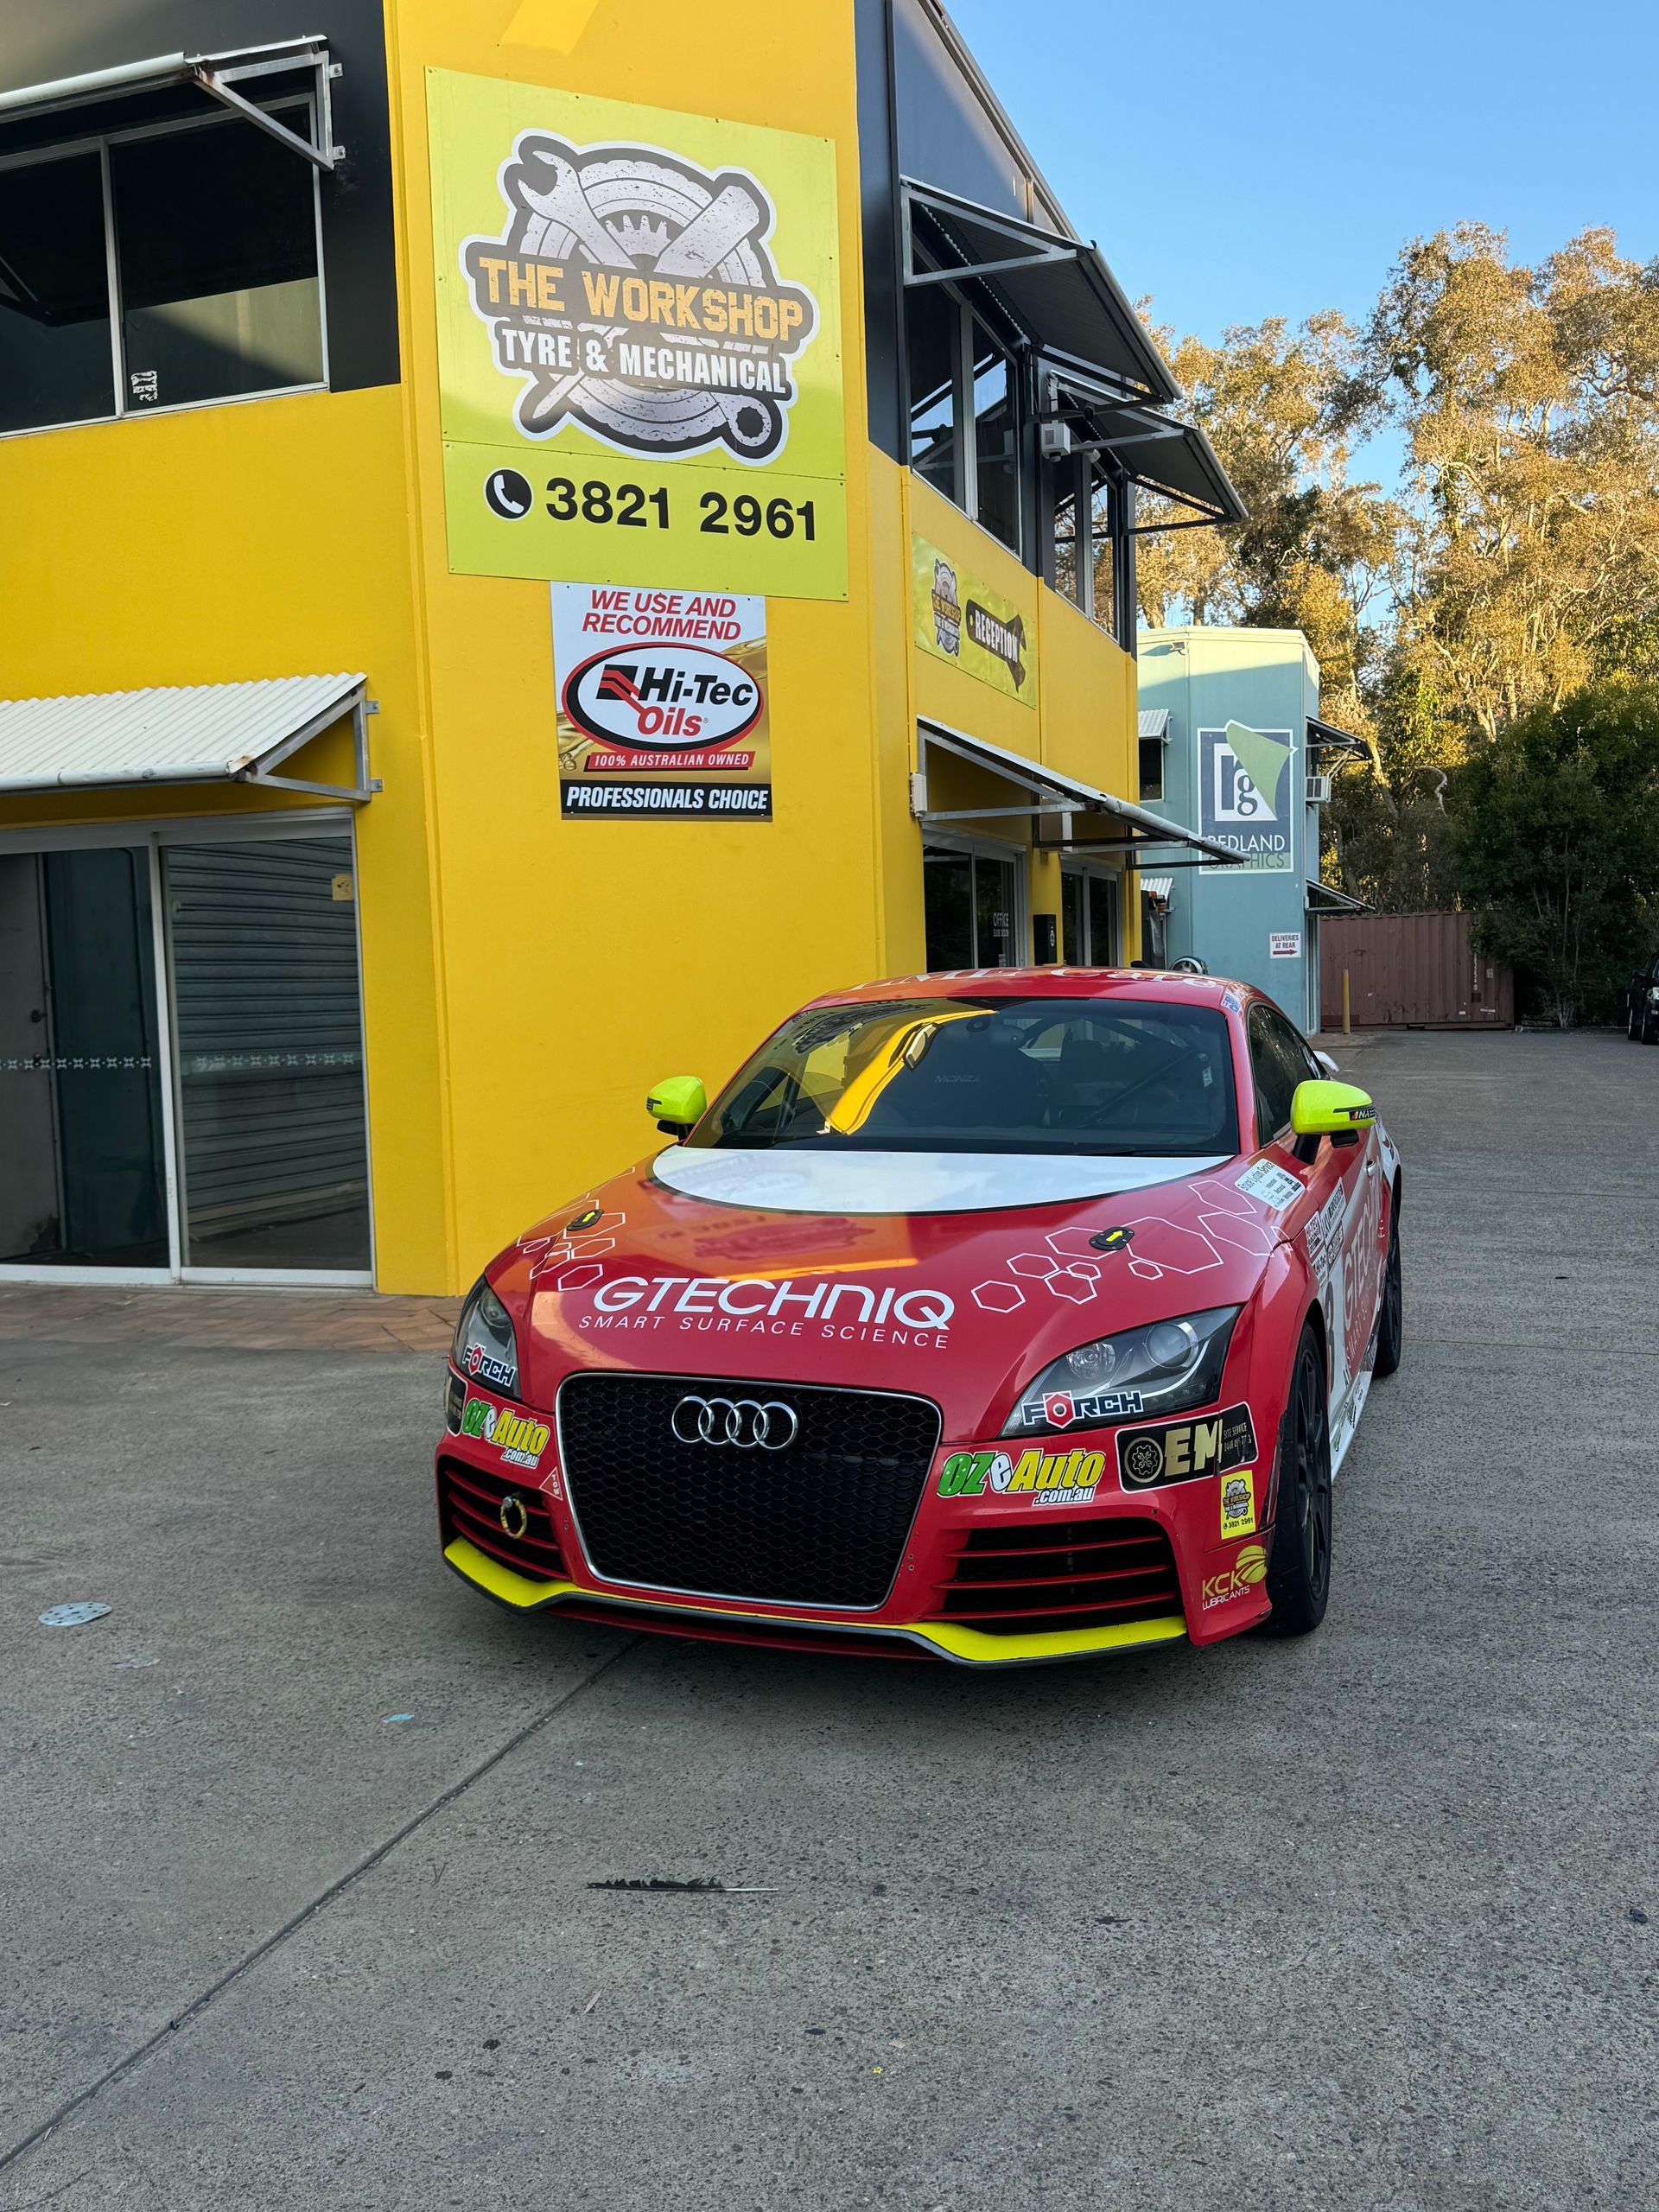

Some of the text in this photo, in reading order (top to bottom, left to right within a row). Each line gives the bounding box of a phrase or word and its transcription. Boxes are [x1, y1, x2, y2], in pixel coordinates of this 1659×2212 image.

[479, 257, 803, 341] THE WORKSHOP
[502, 327, 786, 395] TYRE & MECHANICAL
[545, 477, 816, 542] 3821 2961
[591, 589, 736, 618] WE USE AND
[582, 613, 741, 640] RECOMMEND
[975, 609, 1019, 663] RECEPTION
[638, 666, 753, 706] Hi-Tec
[638, 706, 702, 736] Oils
[594, 753, 750, 767] 100% AUSTRALIAN OWNED
[567, 786, 768, 810] PROFESSIONALS CHOICE
[1209, 852, 1285, 869] HICS
[993, 912, 1009, 927] OFFICE
[593, 1276, 955, 1331] GTECHNIQ
[578, 1315, 950, 1350] SMART SURFACE SCIENCE
[502, 1449, 538, 1466] .com.au
[1034, 1486, 1094, 1505] .com.au
[1202, 1566, 1246, 1601] KCK
[1202, 1585, 1250, 1611] LUBRICANTS
